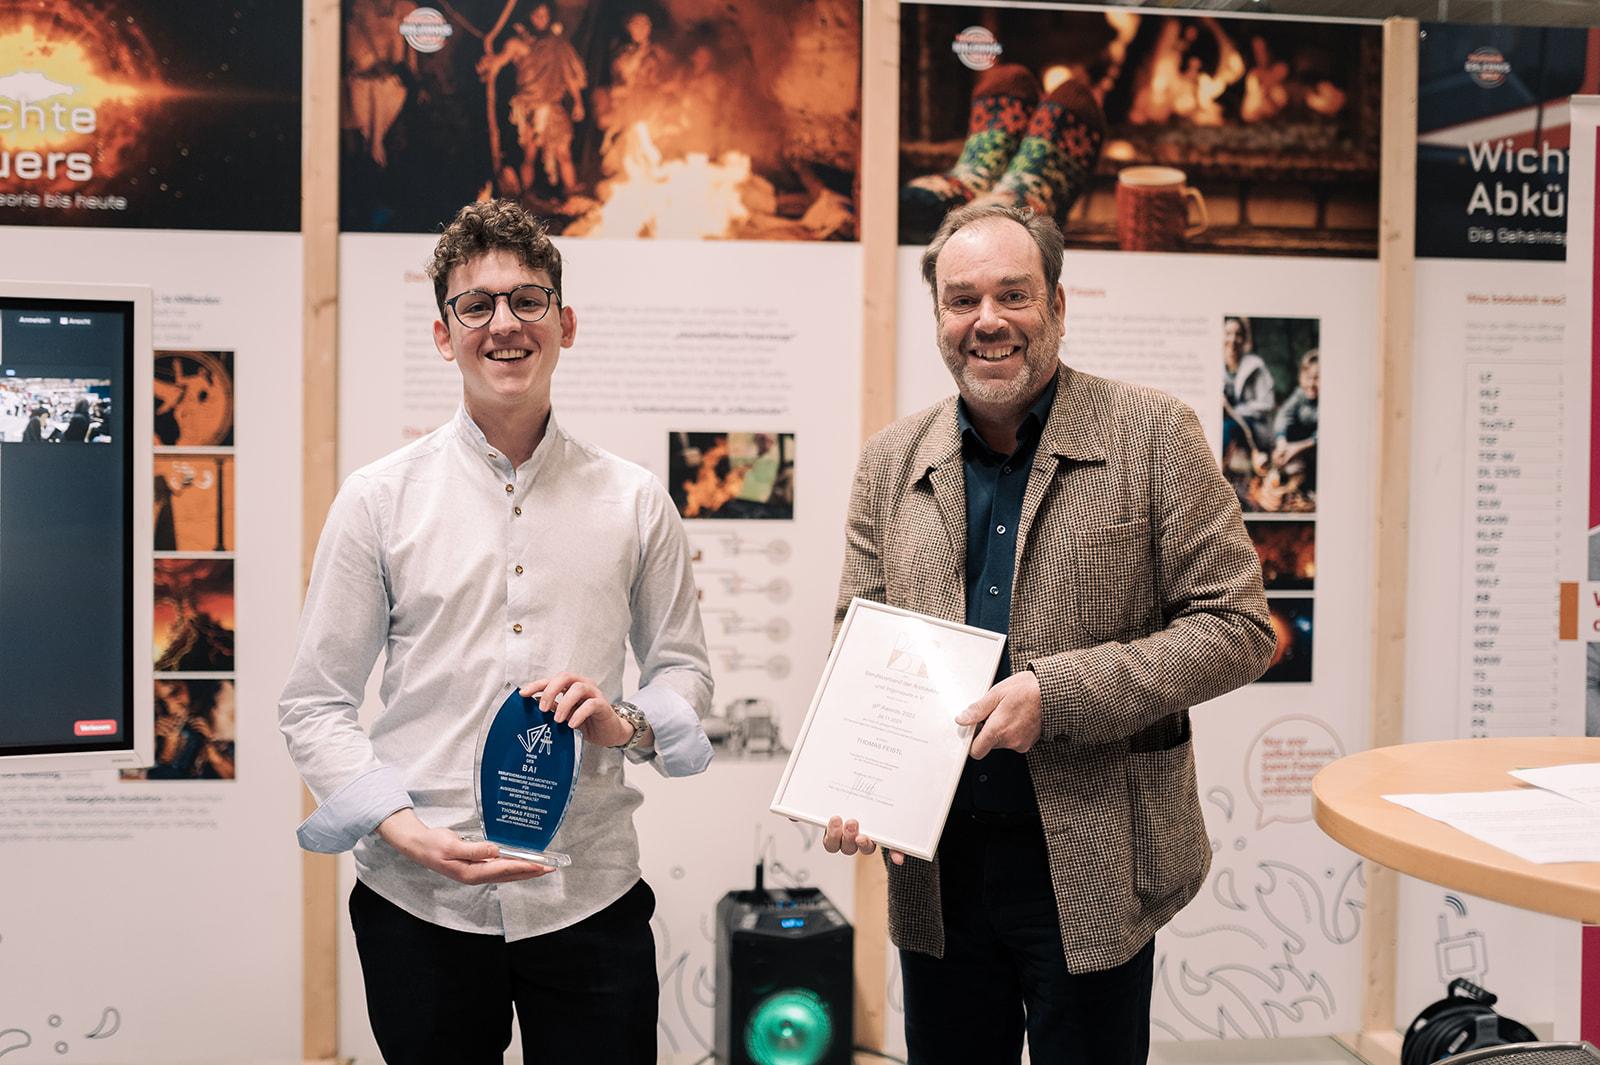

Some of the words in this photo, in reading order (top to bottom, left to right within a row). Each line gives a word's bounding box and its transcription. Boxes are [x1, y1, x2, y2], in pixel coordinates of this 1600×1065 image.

[1467, 139, 1569, 175] Wich
[45, 192, 72, 209] bis
[74, 192, 128, 211] heute
[1468, 227, 1493, 243] Die
[522, 764, 537, 773] BAI
[501, 807, 523, 816] THOMAS
[523, 811, 541, 819] FEISTL
